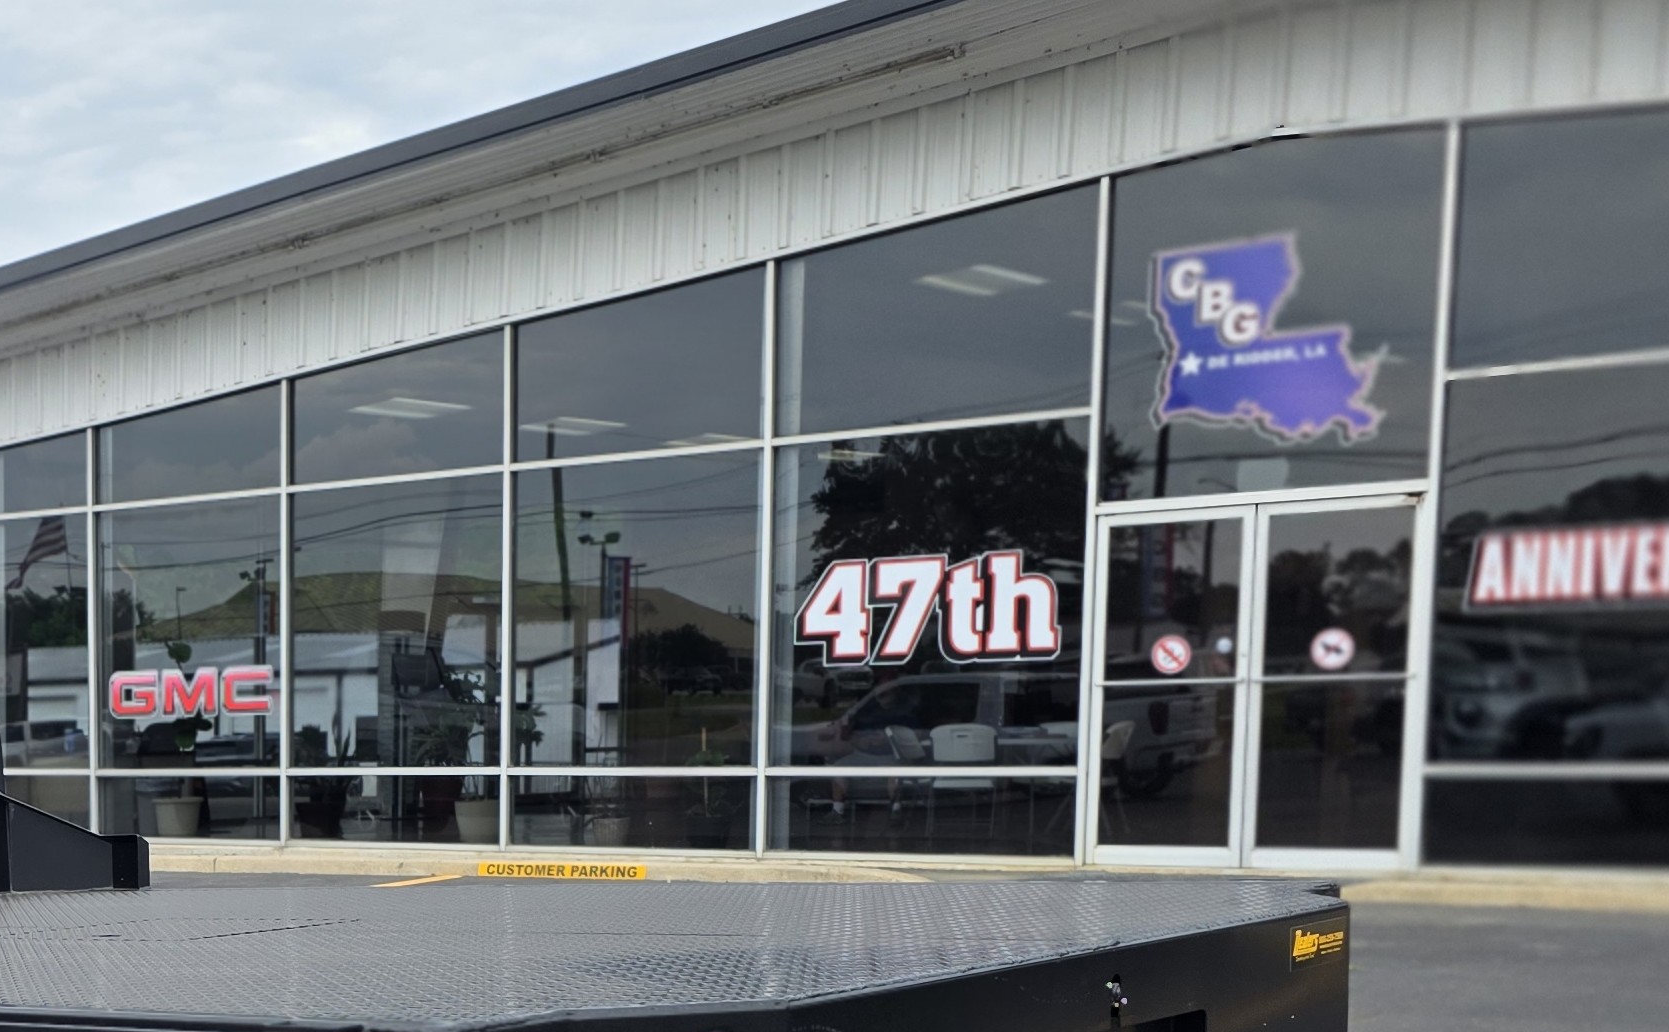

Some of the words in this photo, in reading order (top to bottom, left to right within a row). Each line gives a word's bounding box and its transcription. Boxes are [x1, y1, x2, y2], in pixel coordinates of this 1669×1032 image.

[1168, 257, 1260, 343] CBG
[1473, 524, 1669, 602] ANNIVE
[796, 550, 1061, 664] 47th
[109, 665, 273, 719] GMC
[486, 863, 566, 878] CUSTOMER
[570, 864, 638, 879] PARKING
